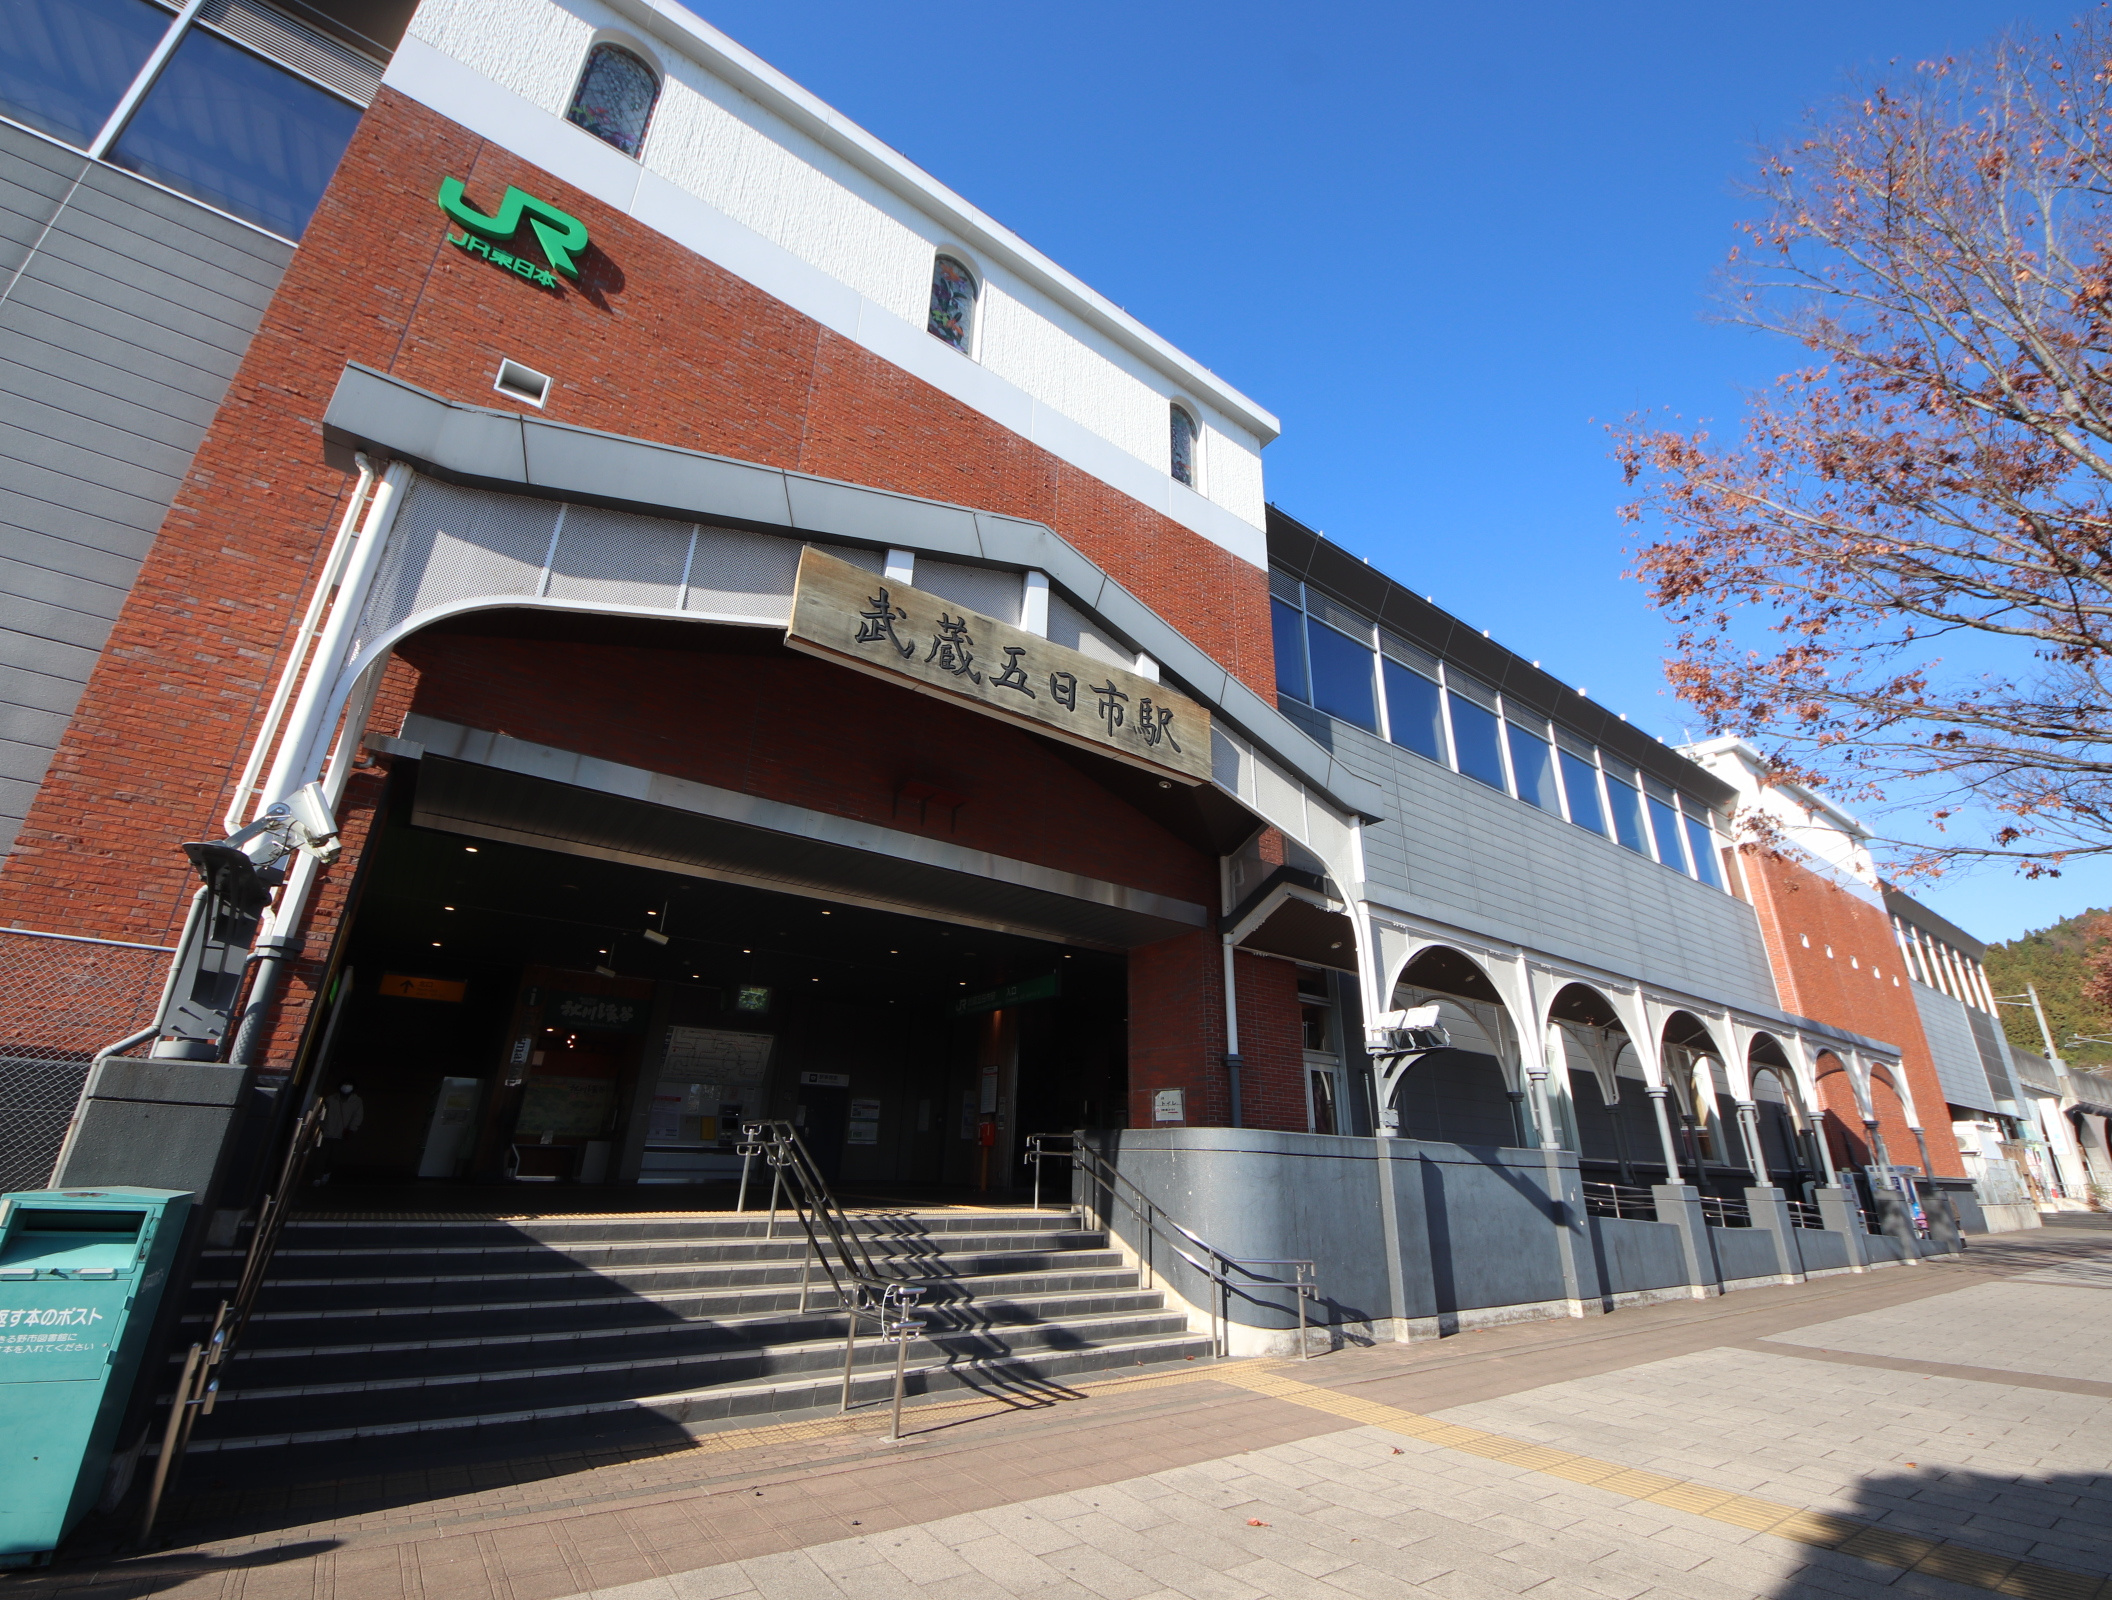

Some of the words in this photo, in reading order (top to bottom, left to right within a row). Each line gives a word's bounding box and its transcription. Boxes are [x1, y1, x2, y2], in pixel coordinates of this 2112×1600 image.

[438, 176, 588, 280] JR
[447, 232, 558, 289] JR東日本
[855, 586, 1181, 754] 武蔵五日市駅
[0, 1343, 94, 1353] 本を入れてください
